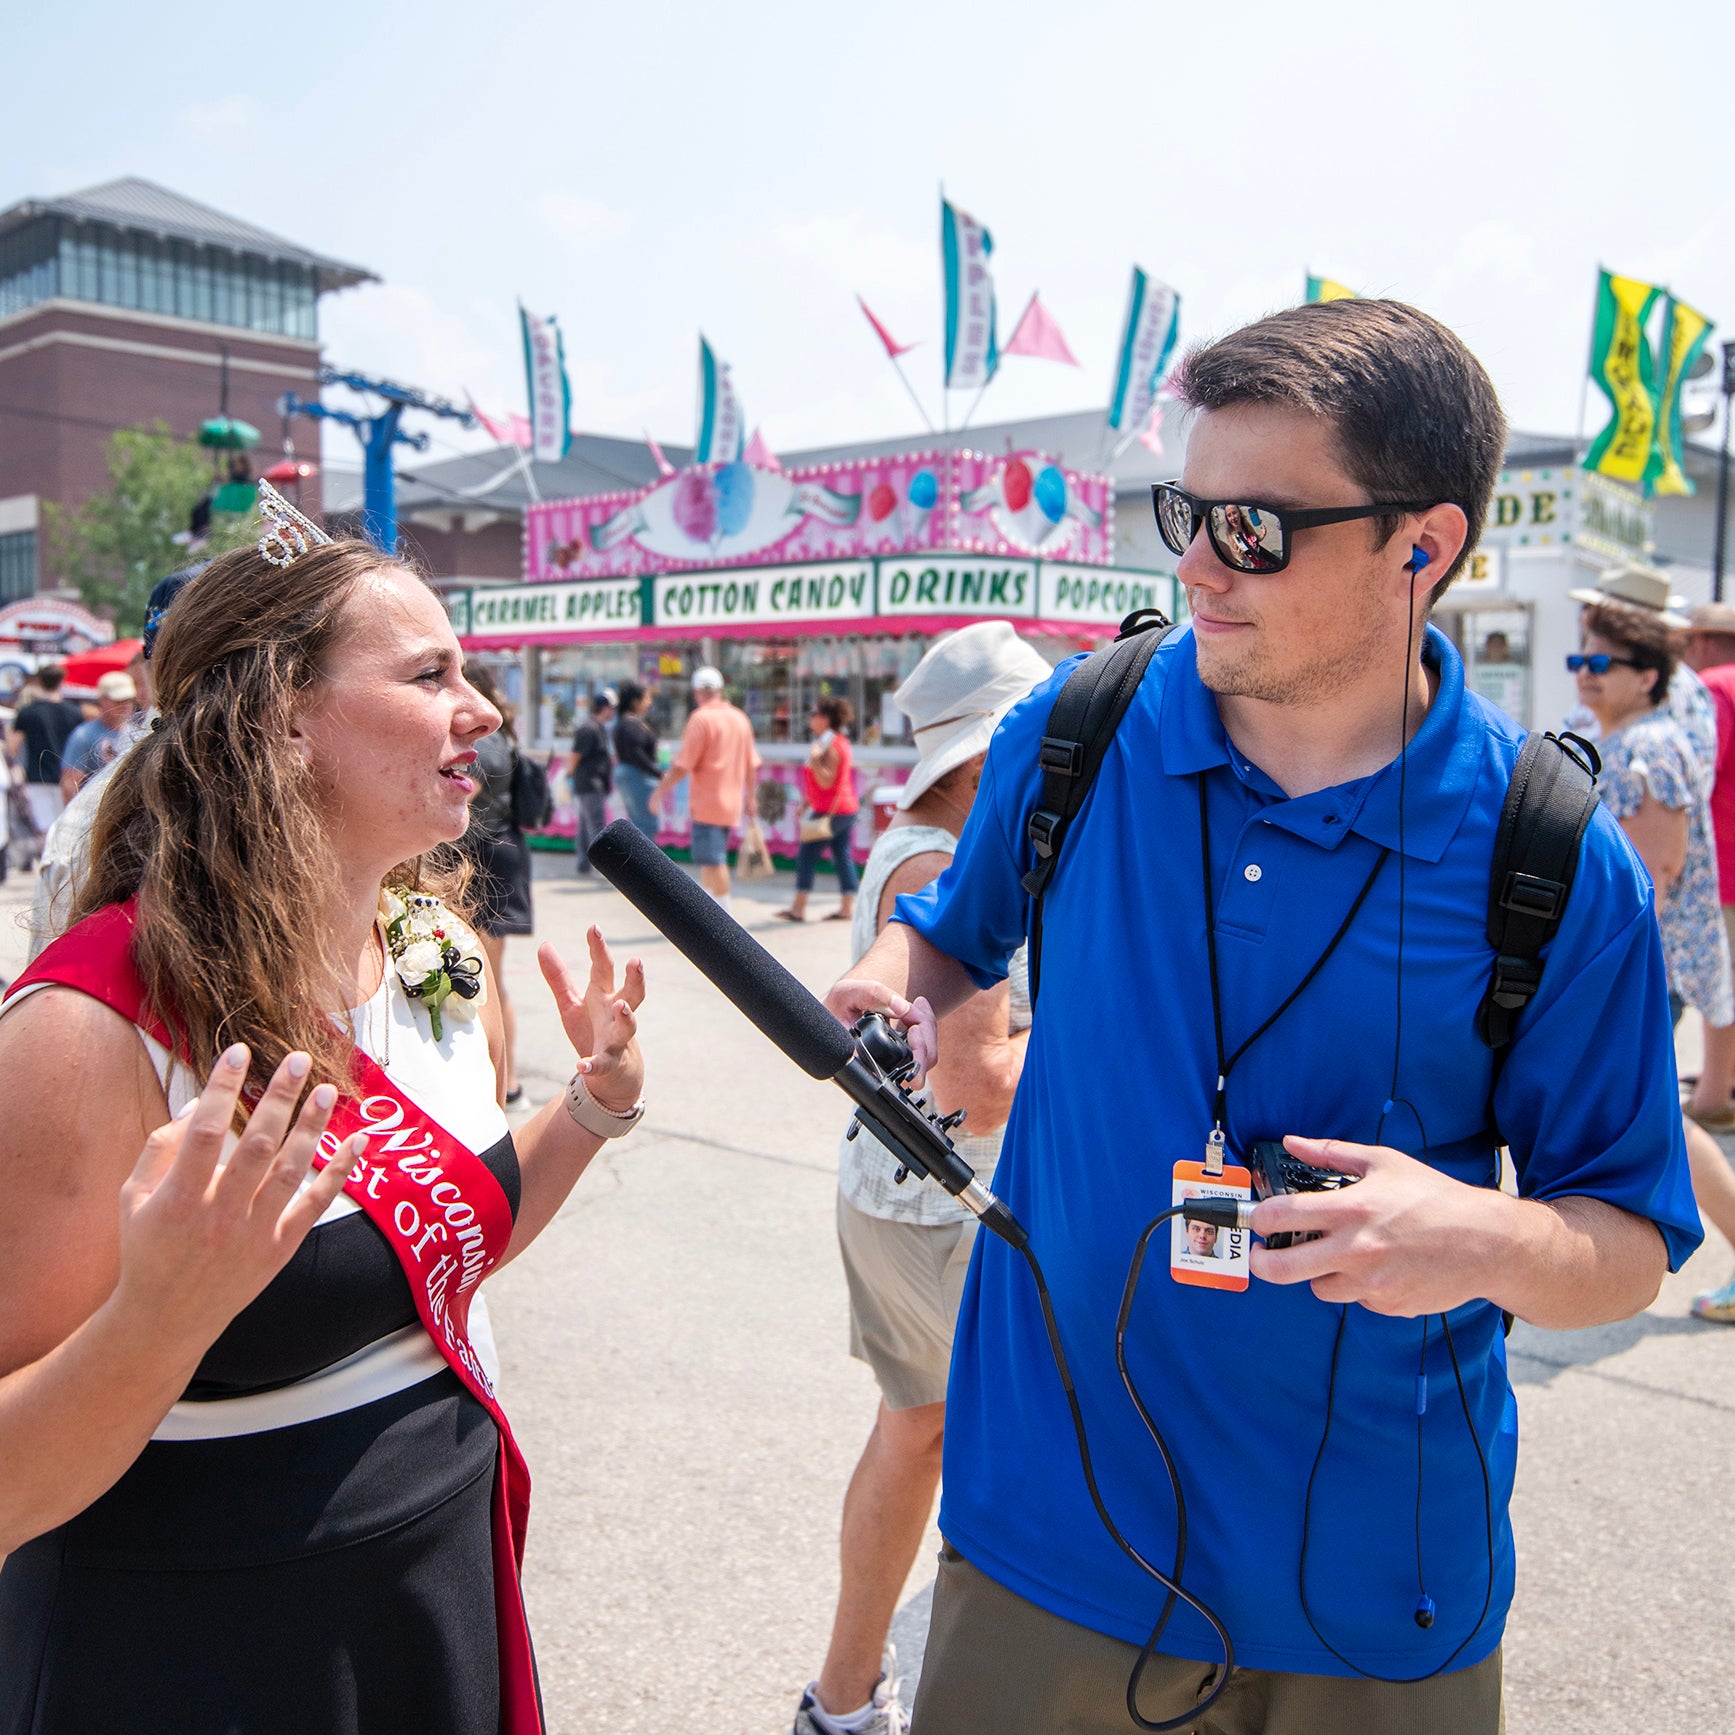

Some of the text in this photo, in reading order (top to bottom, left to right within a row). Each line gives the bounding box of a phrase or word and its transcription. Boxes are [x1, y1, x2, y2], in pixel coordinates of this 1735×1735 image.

[1496, 491, 1556, 527] DE
[663, 572, 867, 616] COTTON CANDY
[890, 567, 1028, 605] DRINKS
[1055, 576, 1156, 612] POPCORN
[474, 594, 557, 625] CARAMEL
[565, 588, 640, 619] APPLES
[357, 1095, 495, 1294] Wisconsin
[1200, 1189, 1243, 1199] WISCONSIN
[1230, 1227, 1242, 1260] EDIA
[394, 1201, 448, 1262] Of
[426, 1254, 459, 1327] the
